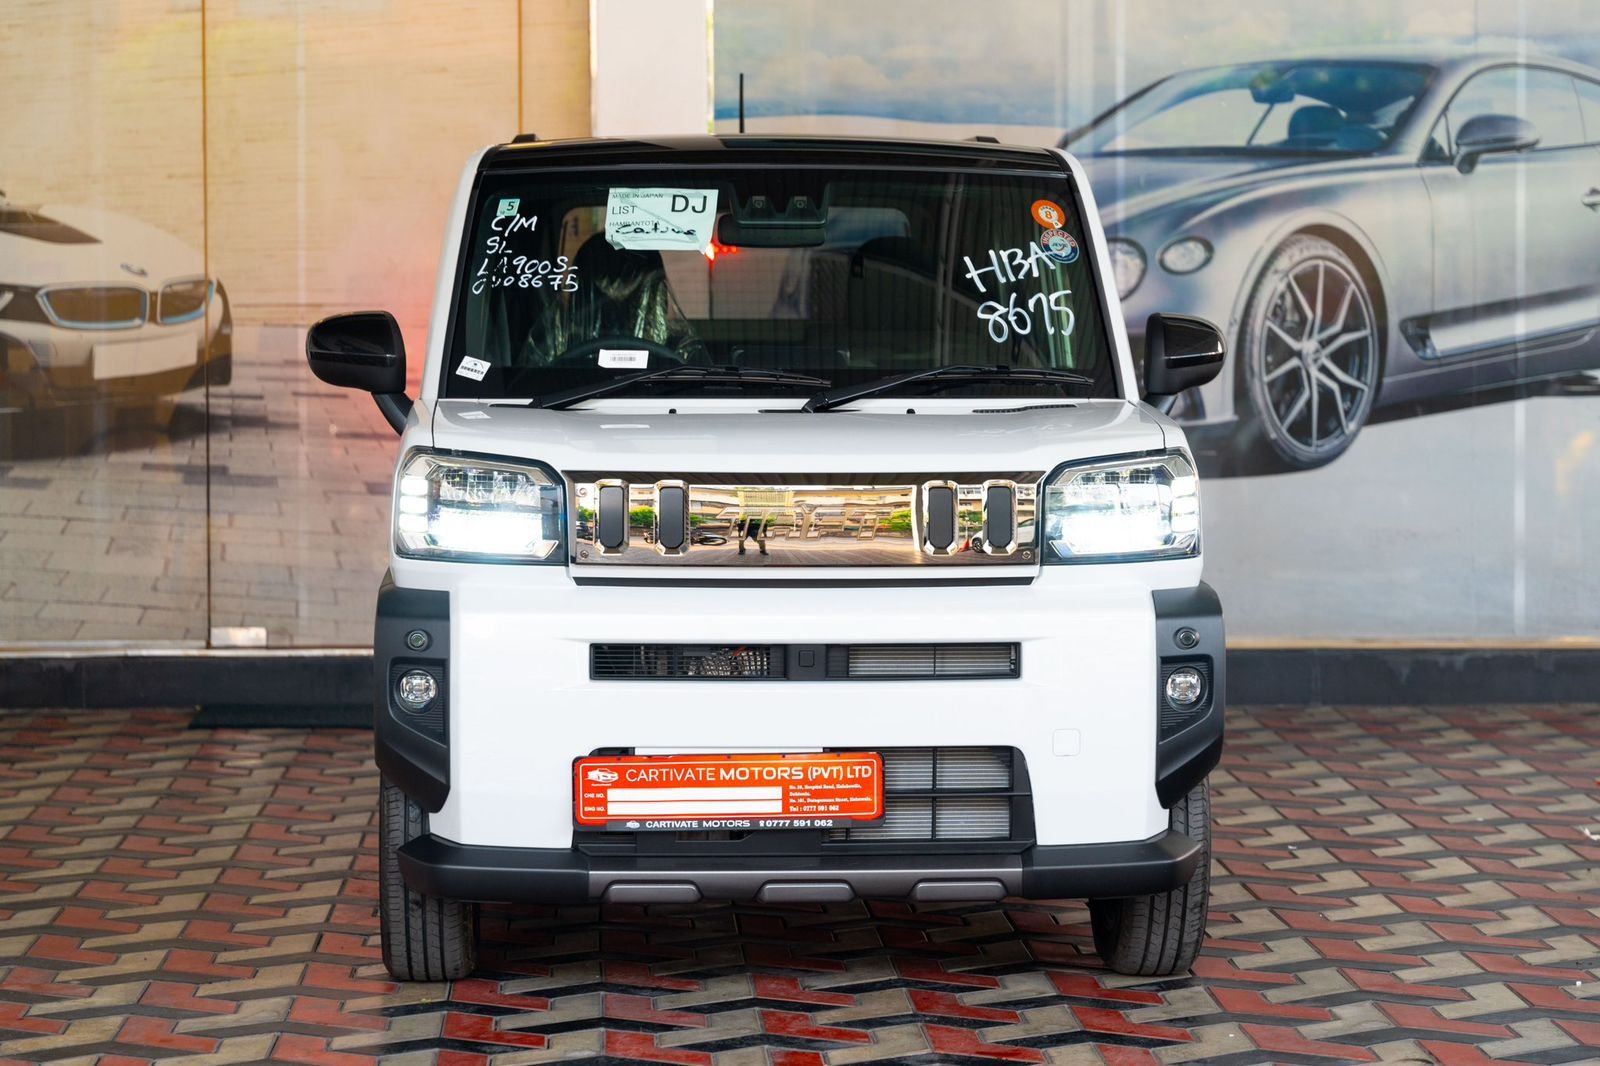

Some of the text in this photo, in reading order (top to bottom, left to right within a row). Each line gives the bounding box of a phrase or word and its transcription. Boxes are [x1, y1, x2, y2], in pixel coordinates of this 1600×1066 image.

[506, 201, 516, 212] 5
[611, 205, 637, 215] LIST
[671, 194, 708, 214] DJ
[963, 241, 1061, 293] HBA
[977, 290, 1075, 343] 8675
[625, 765, 872, 783] CARTIVATE MOTORS (PVT) LTD
[645, 820, 699, 829] CARTIVATE
[702, 819, 751, 828] MOTORS
[766, 820, 790, 828] 0777
[814, 819, 833, 827] 062
